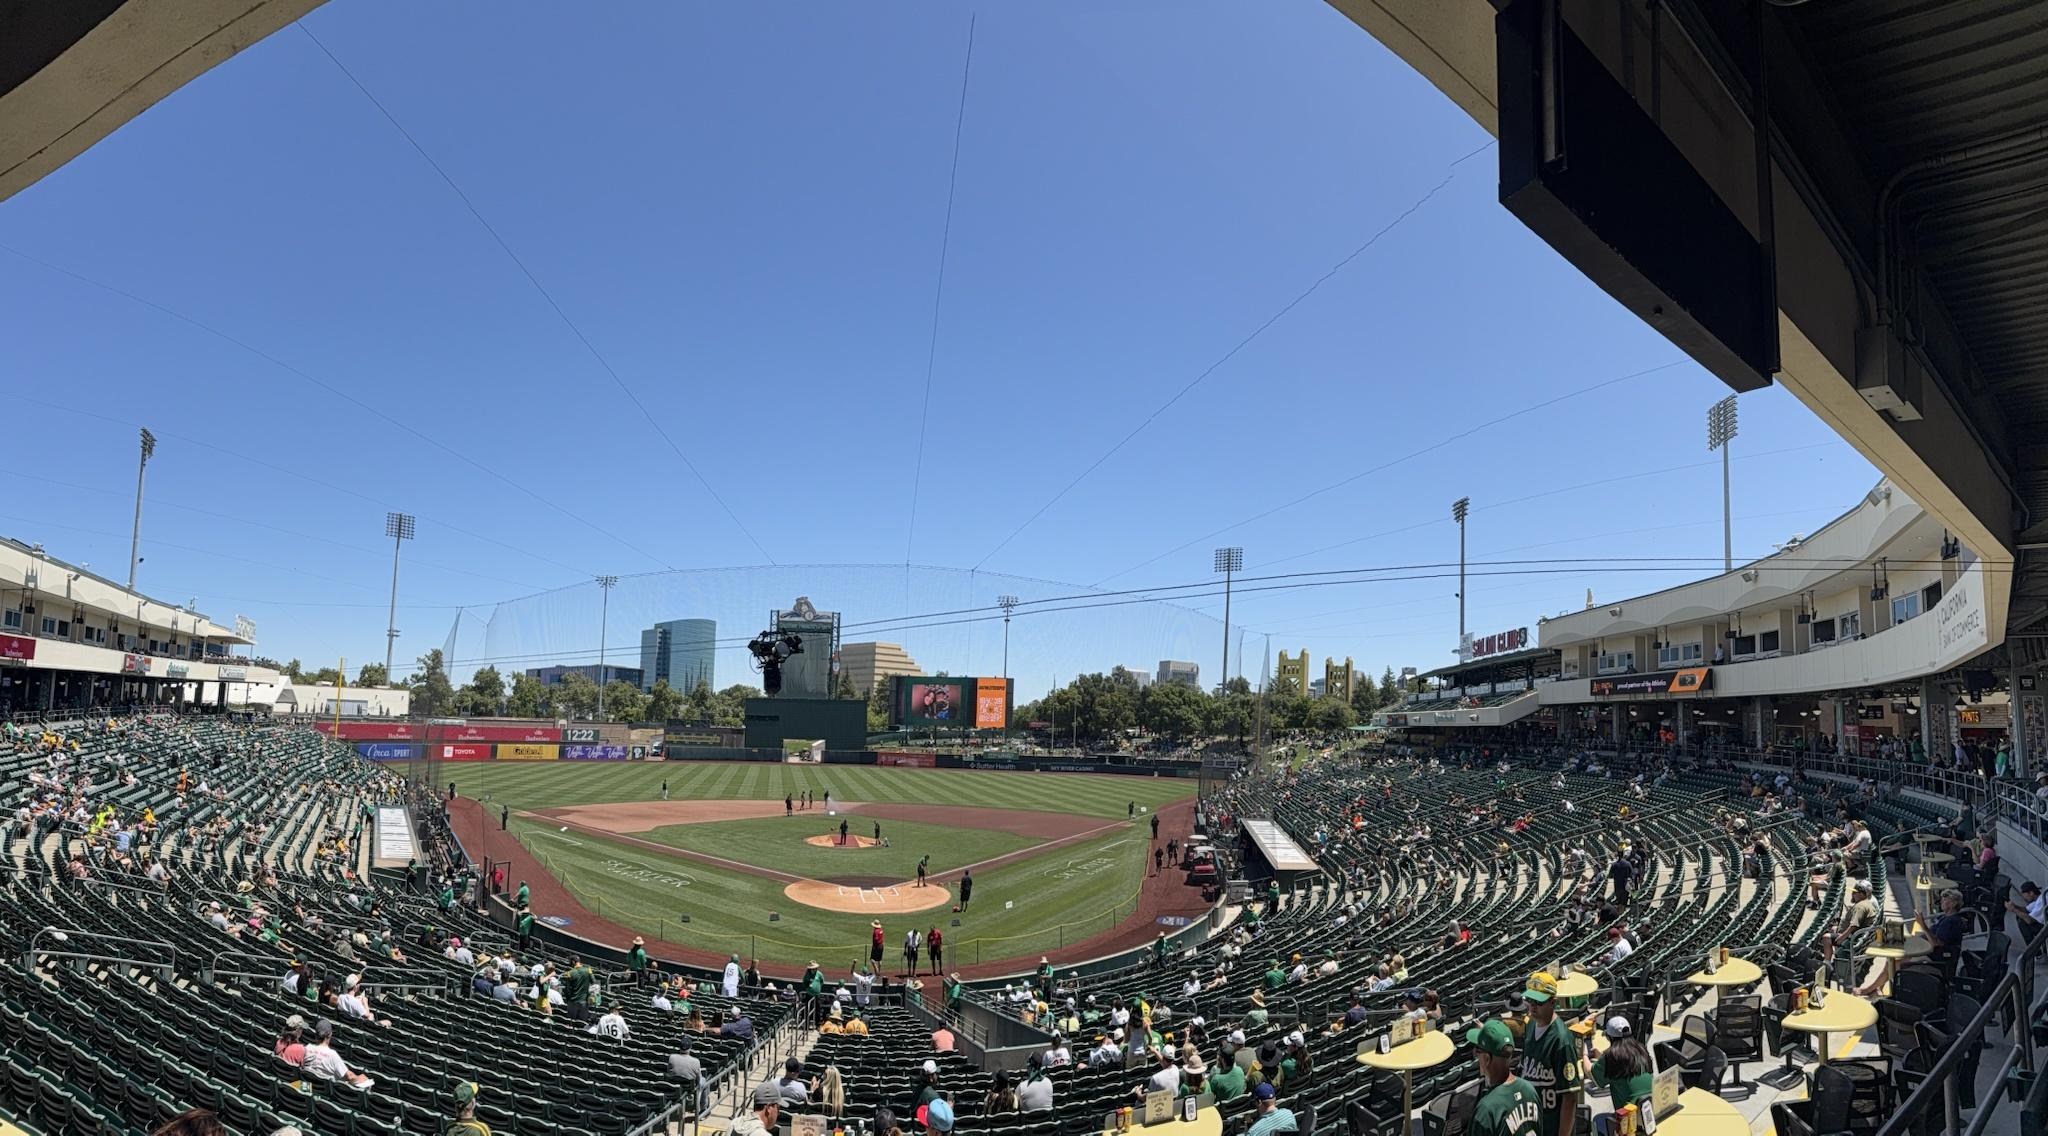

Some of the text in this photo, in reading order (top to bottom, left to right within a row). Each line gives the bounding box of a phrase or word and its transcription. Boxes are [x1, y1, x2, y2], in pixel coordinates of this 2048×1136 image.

[567, 730, 594, 741] 12:22
[367, 744, 390, 757] Circa
[976, 761, 1016, 770] Sutter Health
[606, 1024, 618, 1037] 16
[1541, 1088, 1557, 1109] 19
[1505, 1101, 1538, 1134] MILLER
